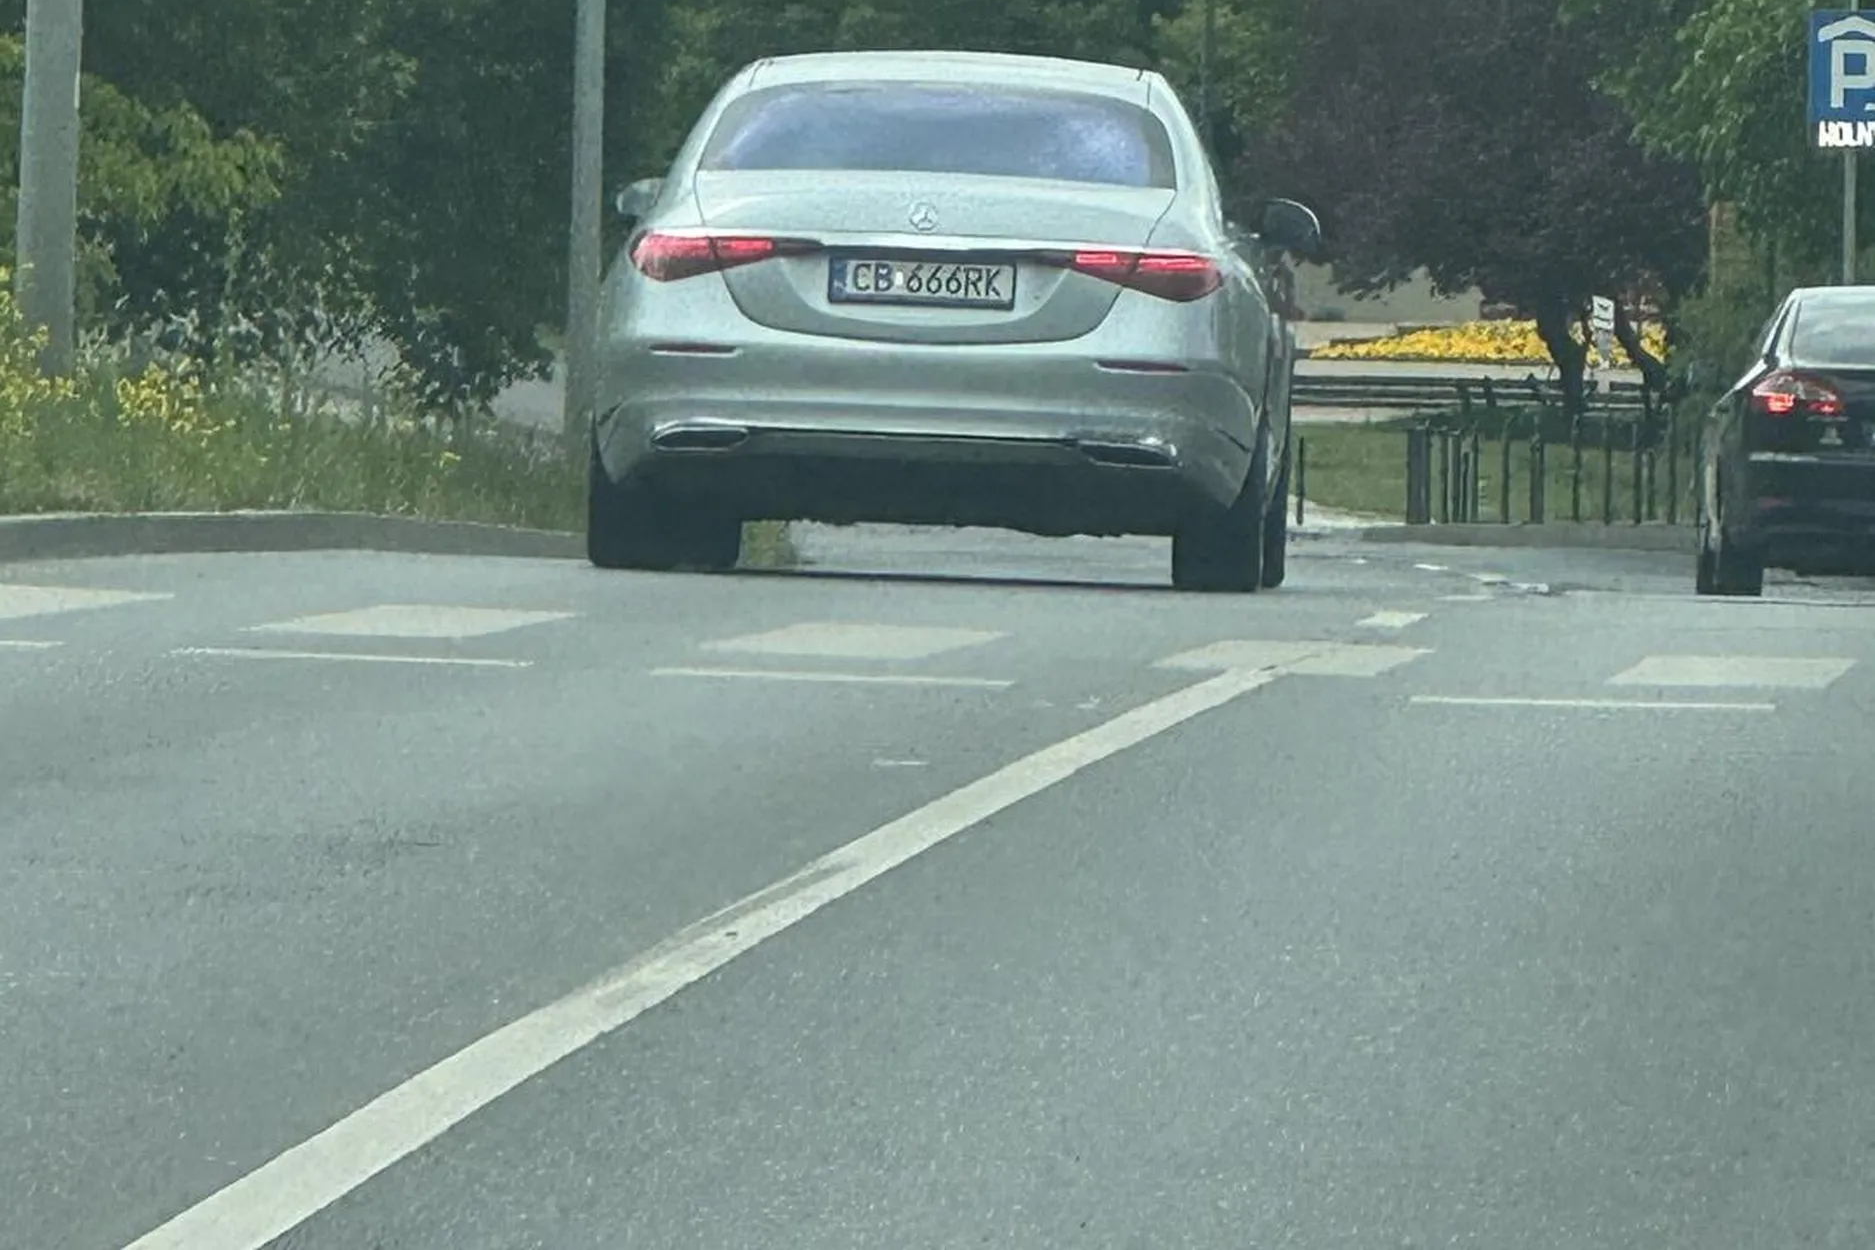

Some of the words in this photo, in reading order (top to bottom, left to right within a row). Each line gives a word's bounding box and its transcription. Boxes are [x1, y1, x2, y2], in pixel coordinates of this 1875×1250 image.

[1831, 39, 1875, 107] P
[853, 263, 894, 292] CB
[906, 264, 1001, 298] 666RK
